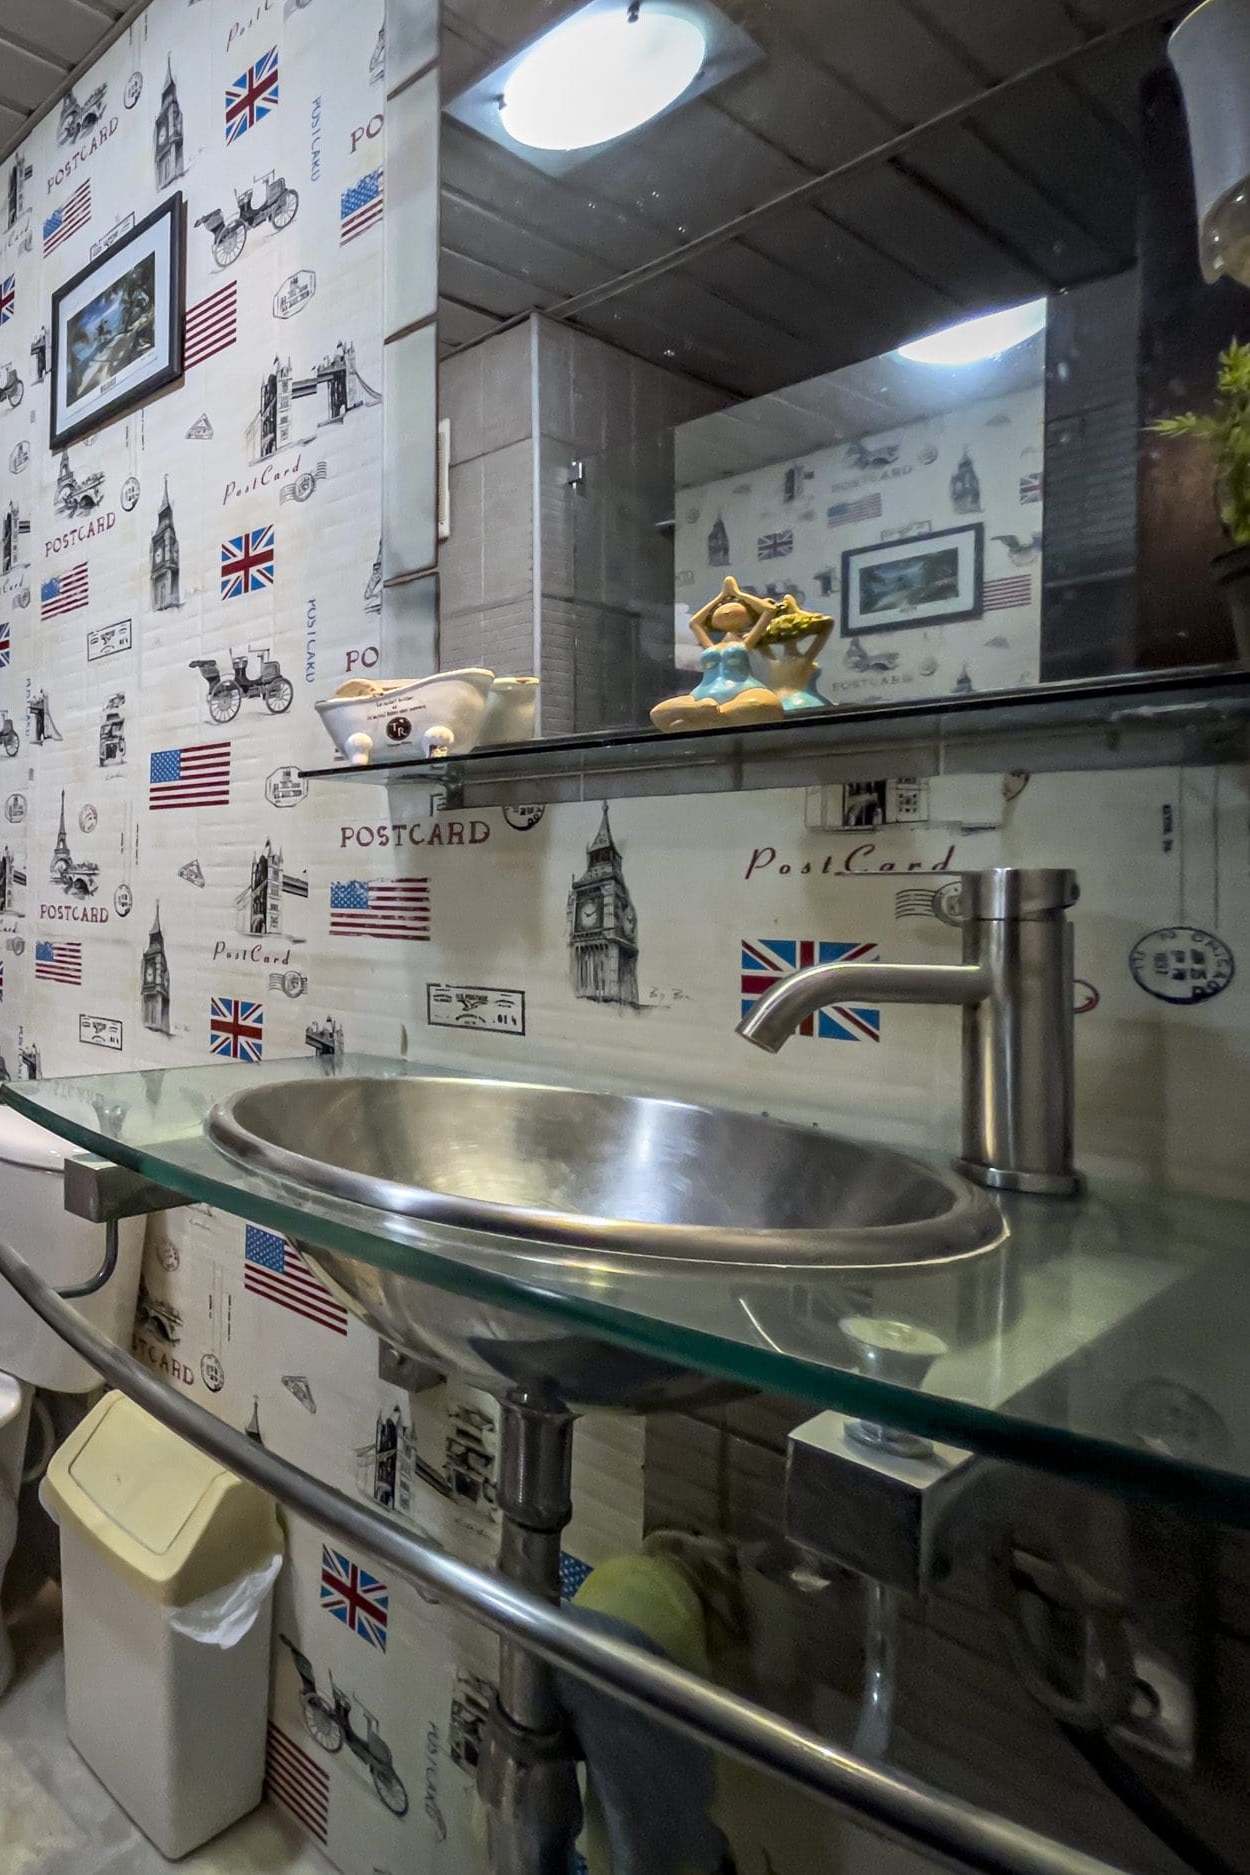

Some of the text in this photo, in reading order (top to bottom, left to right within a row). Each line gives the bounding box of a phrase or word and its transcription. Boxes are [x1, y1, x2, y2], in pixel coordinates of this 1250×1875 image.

[46, 117, 119, 195] POSTCARD
[223, 454, 301, 505] PostCard
[45, 512, 116, 558] POSTCARD
[340, 821, 491, 848] POSTCARD
[745, 844, 956, 880] PostCard
[40, 904, 109, 923] POSTCARD
[213, 941, 290, 966] PostCard
